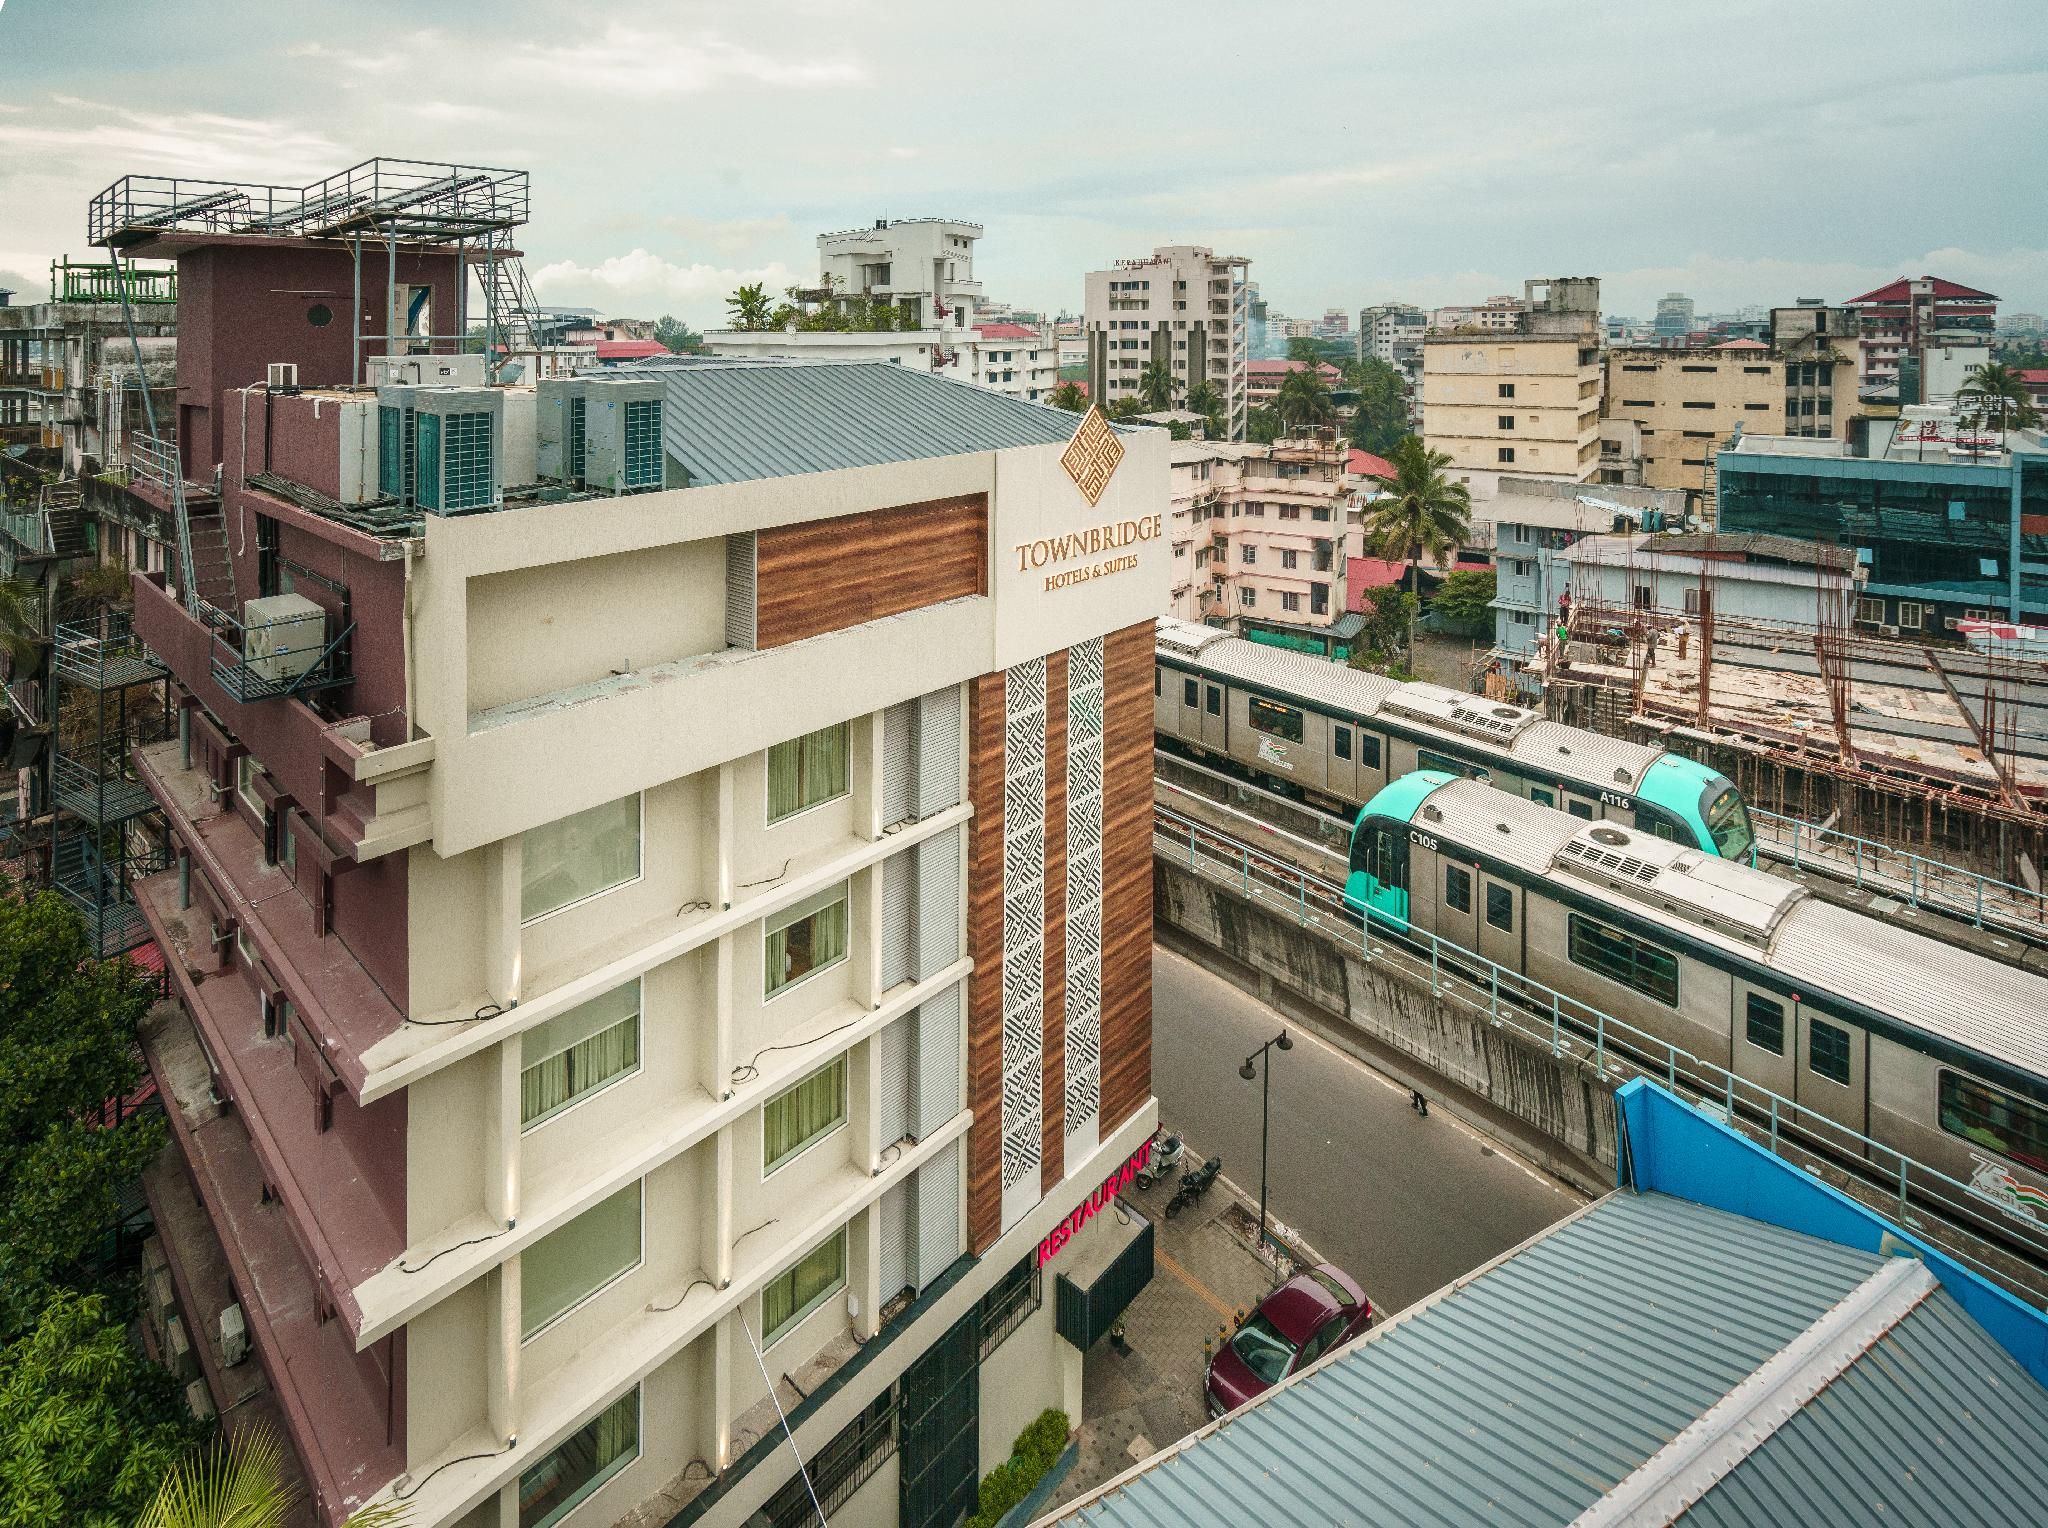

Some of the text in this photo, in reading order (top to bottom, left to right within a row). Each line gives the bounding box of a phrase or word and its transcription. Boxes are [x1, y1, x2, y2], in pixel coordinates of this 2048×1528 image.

[1015, 513, 1162, 572] TOWNBRIDGE
[1044, 553, 1138, 592] HOTELS & SUITES
[1599, 791, 1629, 809] A116
[1410, 830, 1438, 851] C105
[1037, 1139, 1154, 1269] RESTAURANT
[1972, 1181, 2015, 1204] Azadi
